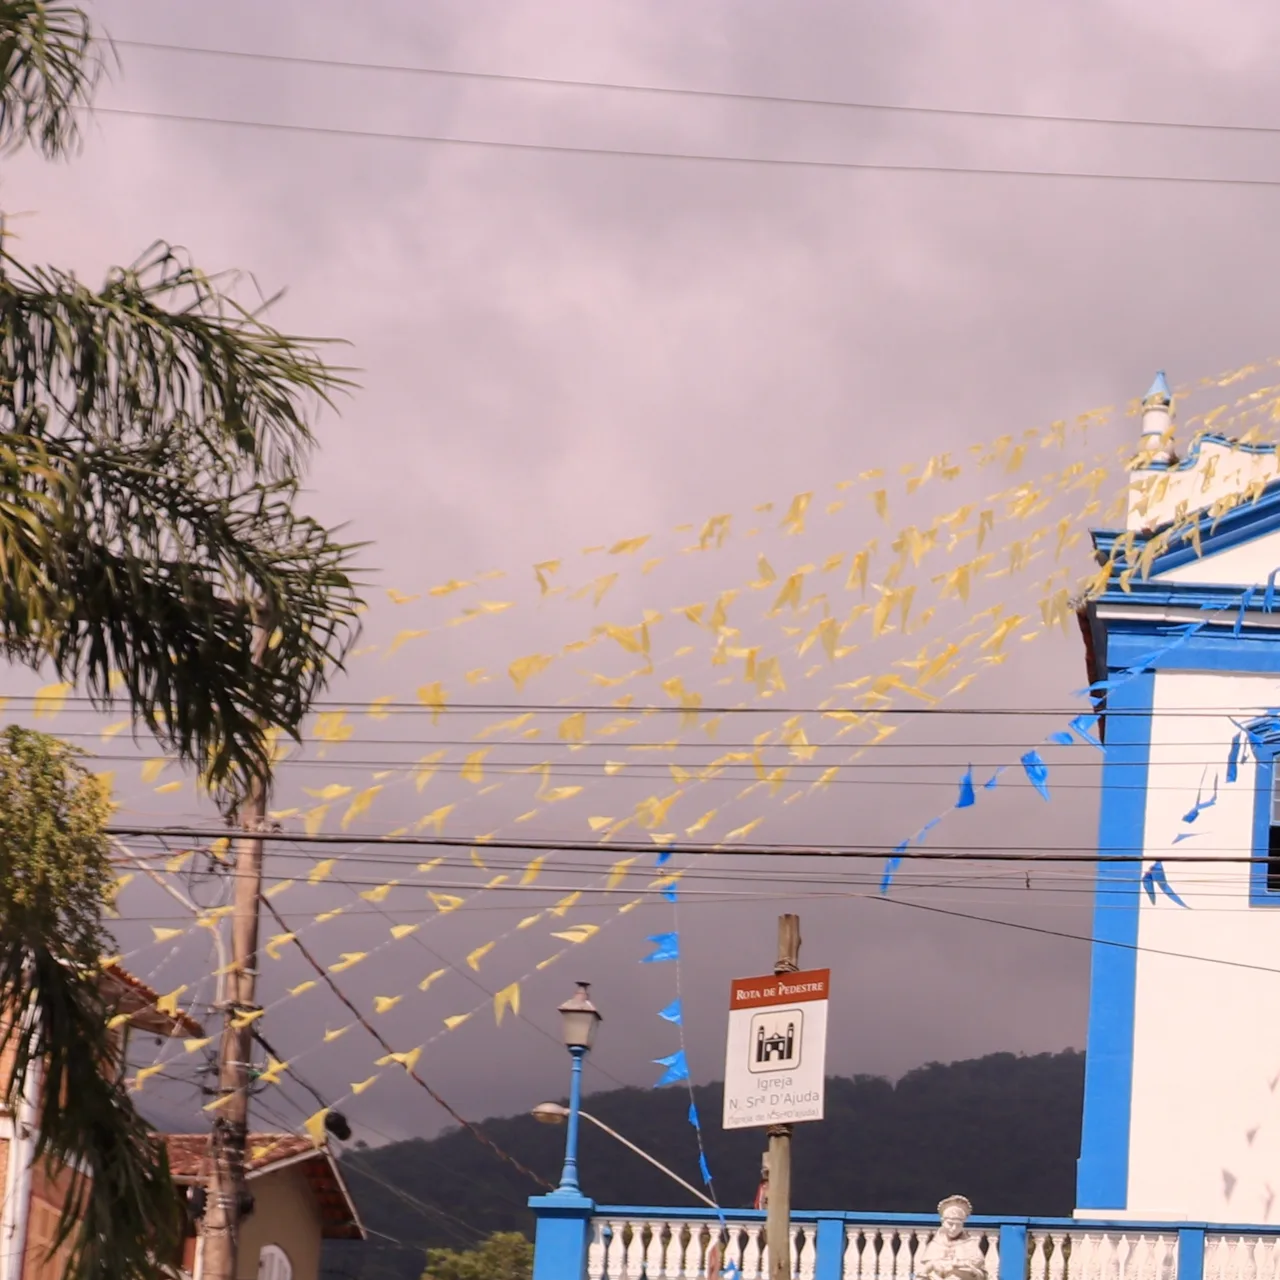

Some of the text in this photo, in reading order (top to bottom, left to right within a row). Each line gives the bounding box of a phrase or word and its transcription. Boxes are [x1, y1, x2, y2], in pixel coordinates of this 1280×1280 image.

[736, 982, 824, 1001] ROTA DE PEDESTRE
[757, 1076, 793, 1092] Igreja
[769, 1091, 820, 1107] D'Ajuda
